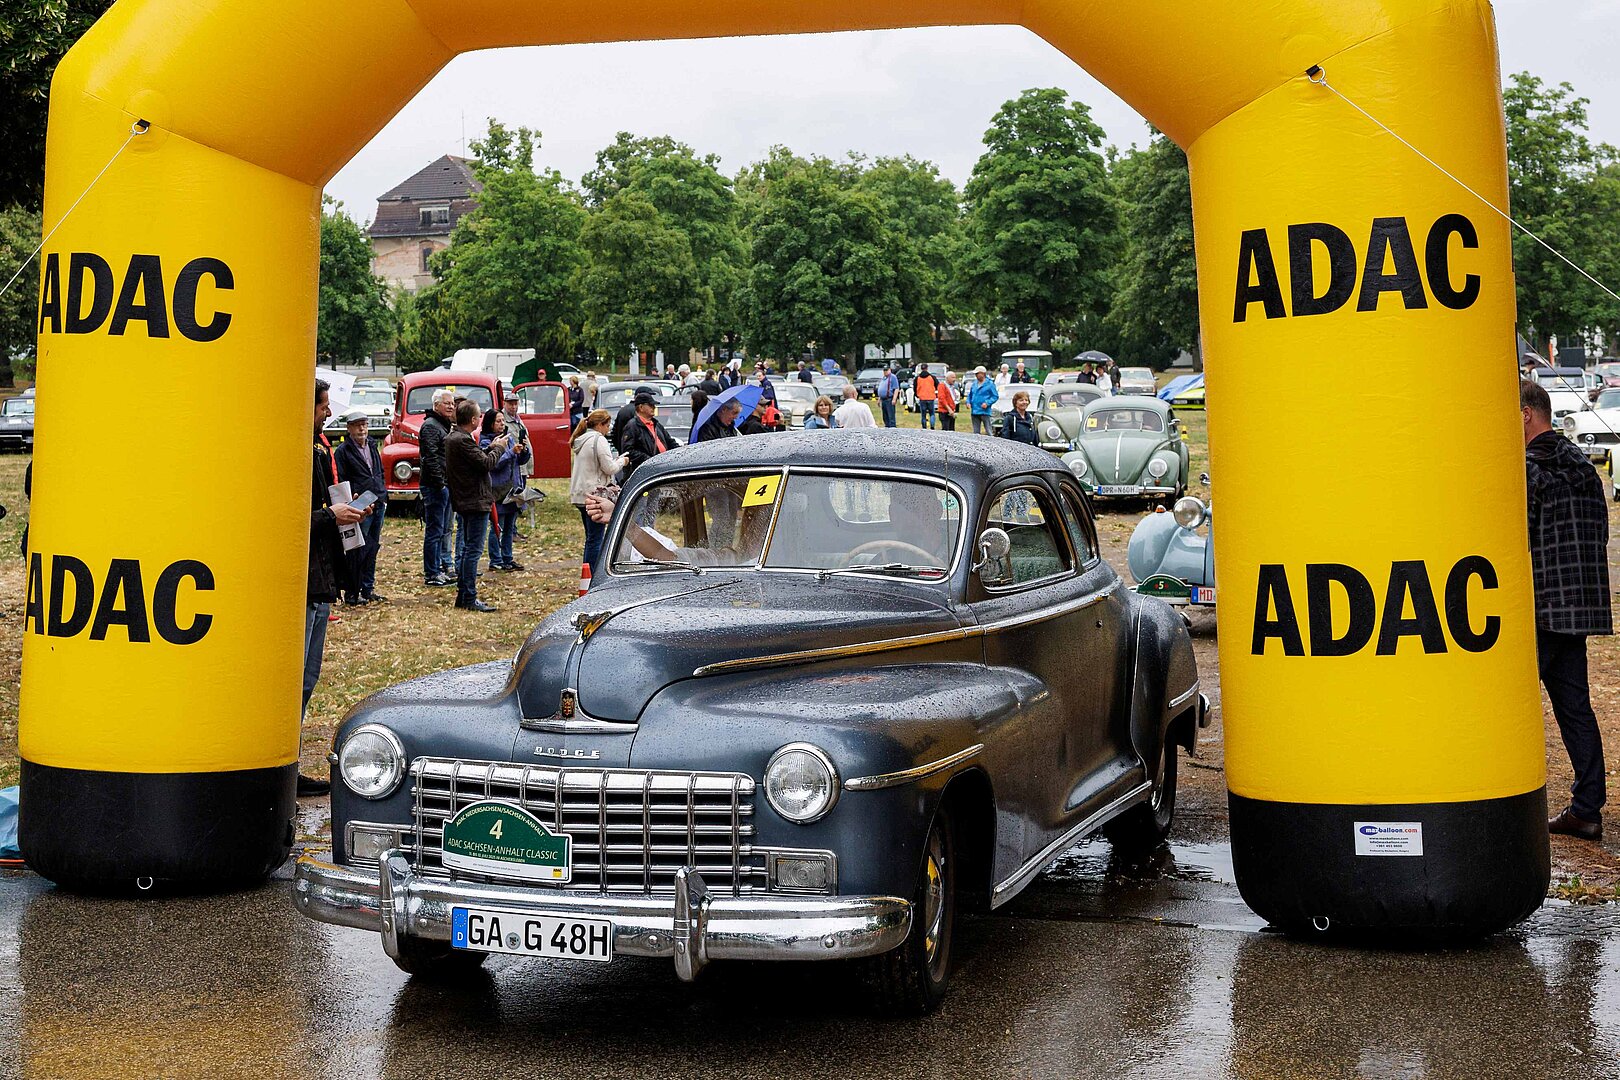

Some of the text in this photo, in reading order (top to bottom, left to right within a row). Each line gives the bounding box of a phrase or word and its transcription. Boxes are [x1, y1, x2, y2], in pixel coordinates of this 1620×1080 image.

[1233, 213, 1481, 323] ADAC
[39, 252, 235, 343] ADAC
[754, 484, 768, 496] 4
[1158, 580, 1164, 590] 5
[1199, 589, 1213, 602] MD
[24, 552, 215, 646] ADAC
[1251, 555, 1501, 657] ADAC
[535, 746, 600, 758] DODGE
[489, 819, 503, 840] 4
[447, 837, 559, 860] ADAC SACHSEN-ANHALT CLASSIC
[468, 914, 503, 948] GA
[524, 920, 542, 951] G
[550, 922, 608, 957] 48H
